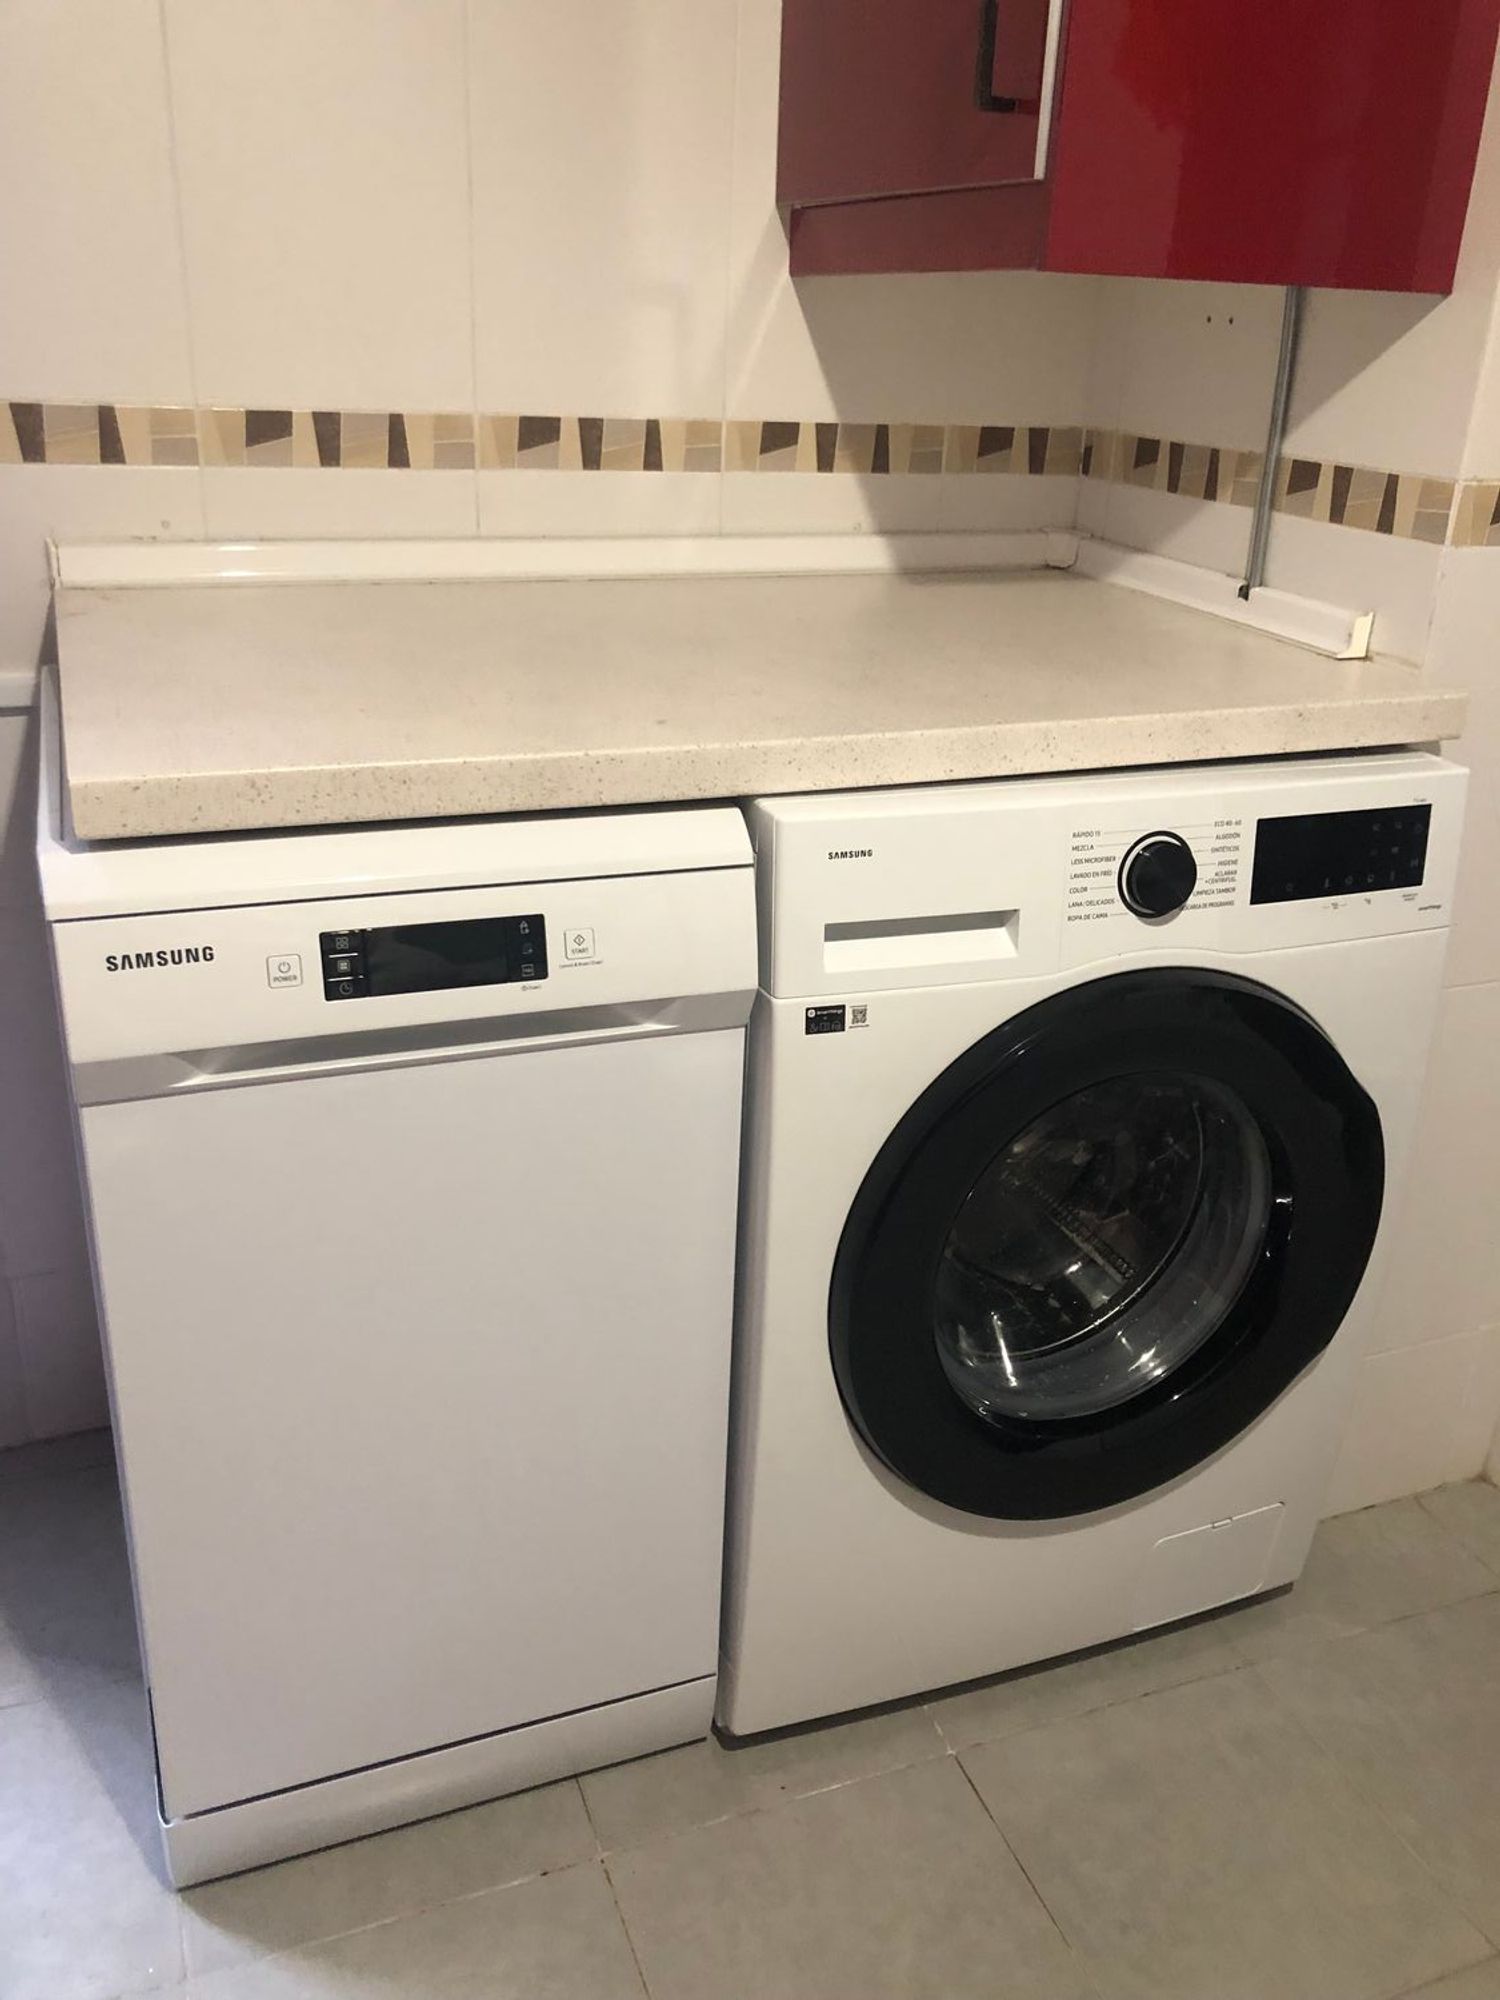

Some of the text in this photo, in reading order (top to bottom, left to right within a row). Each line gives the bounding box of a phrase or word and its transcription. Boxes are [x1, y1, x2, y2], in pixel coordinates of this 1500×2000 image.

[1071, 844, 1095, 852] MEZCLA
[828, 849, 873, 860] SAMSUNG
[1084, 855, 1116, 864] MICROFIBER
[1069, 872, 1092, 880] LAVADO
[1069, 886, 1088, 895] COLOR
[105, 946, 215, 972] SAMSUNG
[273, 974, 298, 983] POWER
